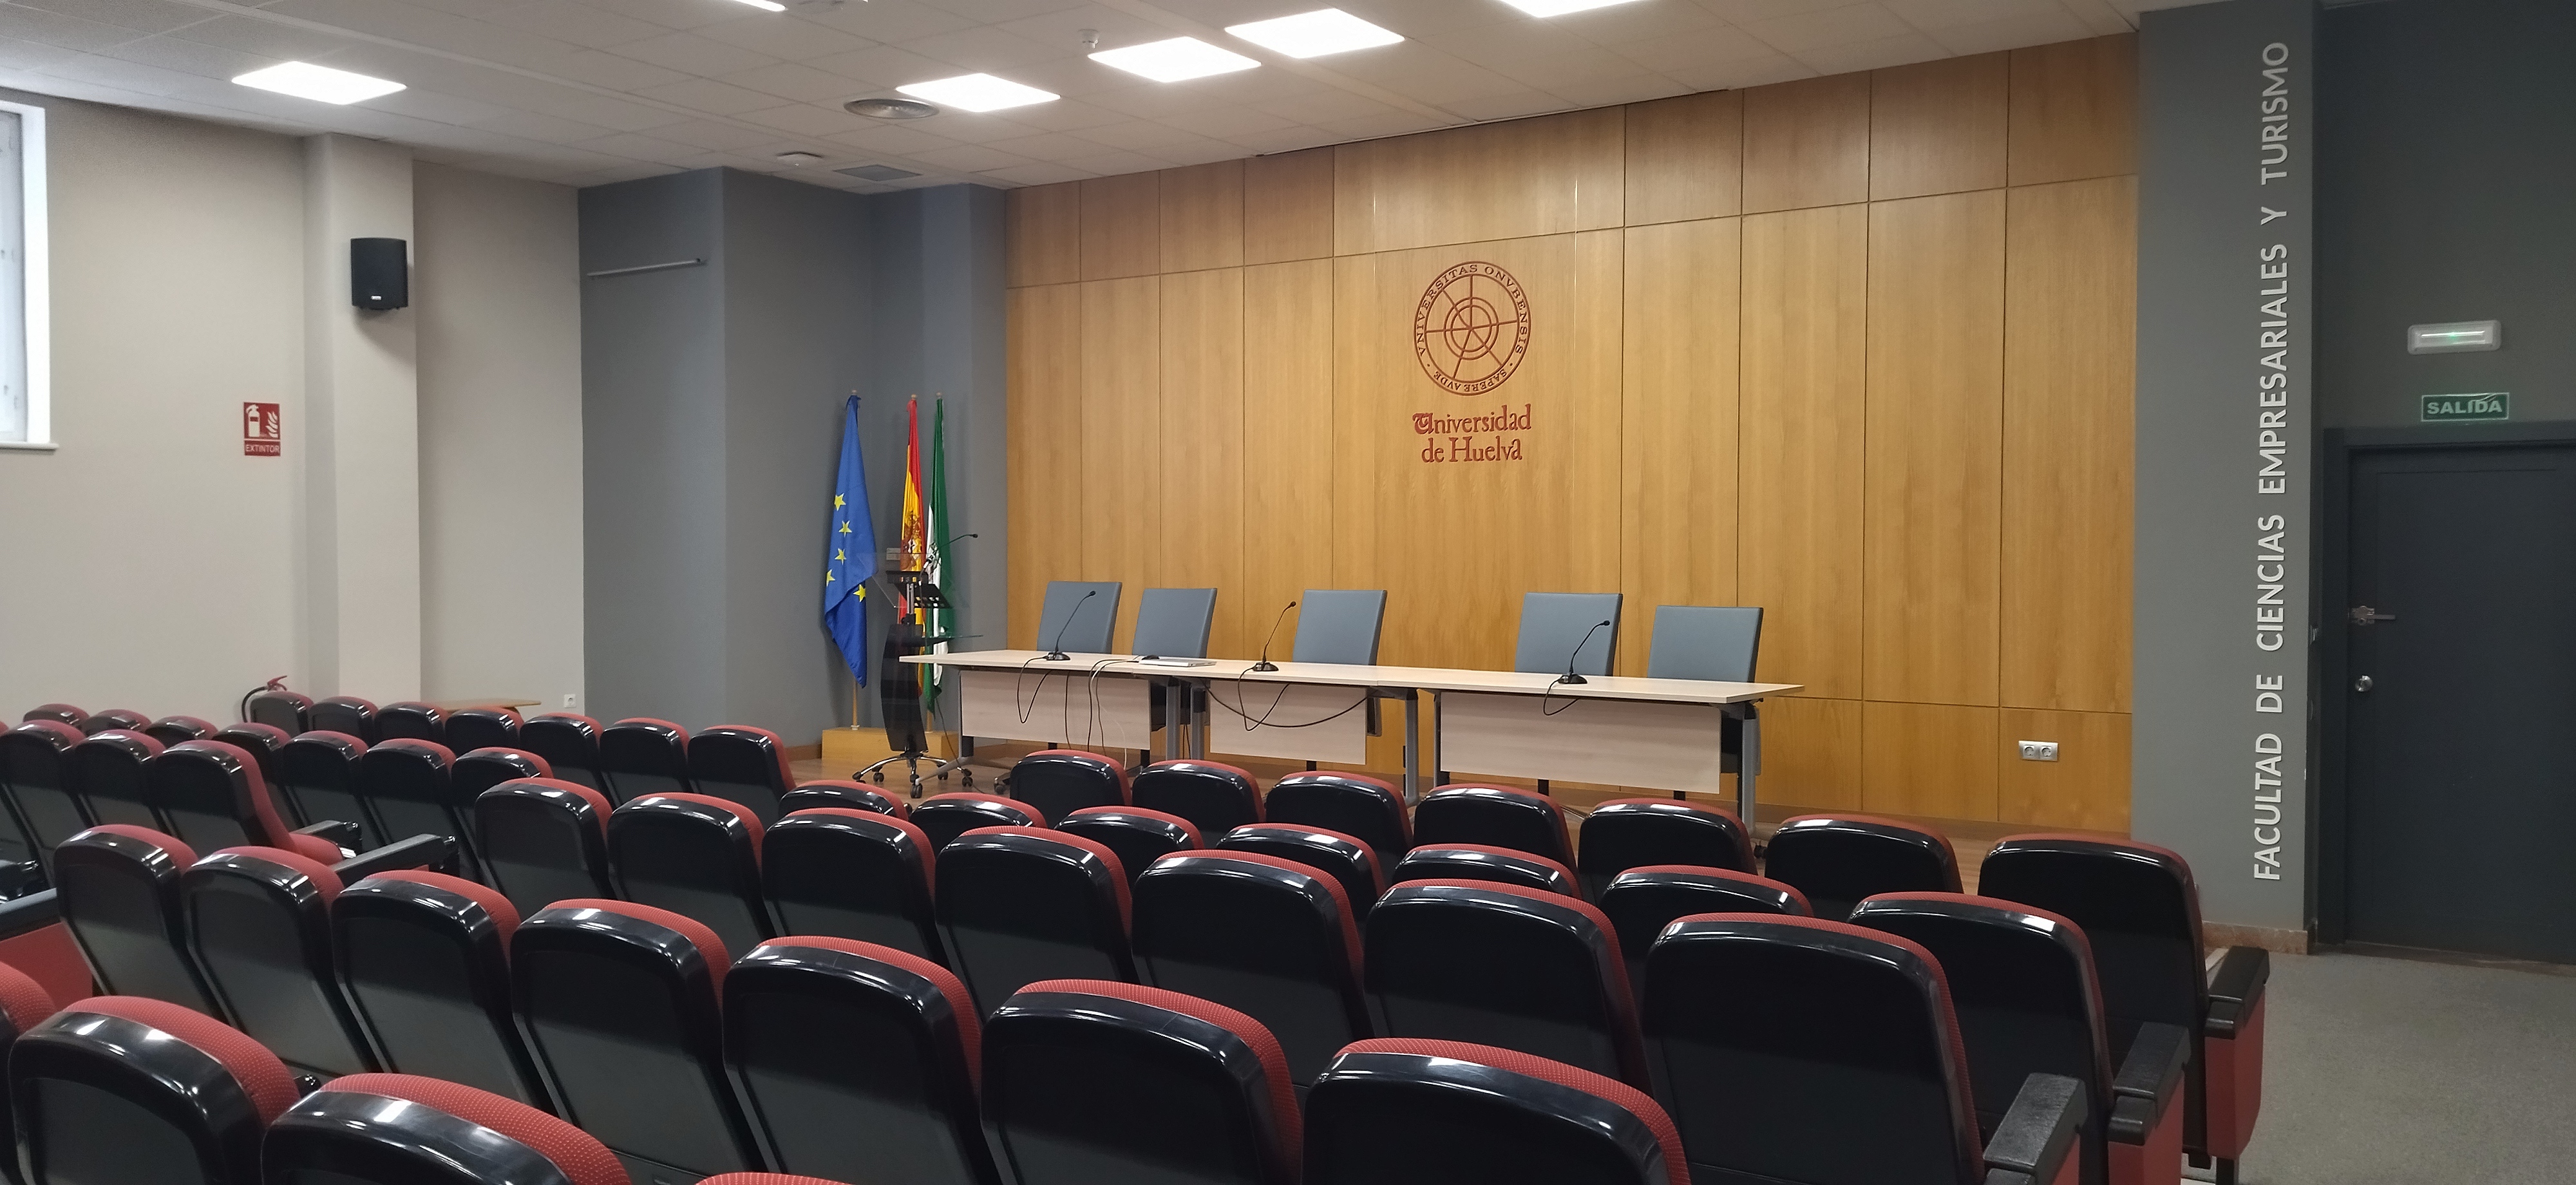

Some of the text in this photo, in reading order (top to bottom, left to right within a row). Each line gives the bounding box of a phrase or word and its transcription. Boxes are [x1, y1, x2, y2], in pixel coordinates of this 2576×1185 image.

[1417, 265, 1528, 356] VNIVERSITAS ONVBENSIS
[1434, 369, 1507, 392] SAPERE AVDE
[1412, 404, 1531, 434] Universidad
[2427, 400, 2503, 414] SALIDA
[246, 444, 279, 453] EXTINTOR
[1421, 435, 1522, 462] de Huelva
[2254, 42, 2289, 880] FACULTAD DE CIENCIAS EMPRESARIALES Y TURISMO
